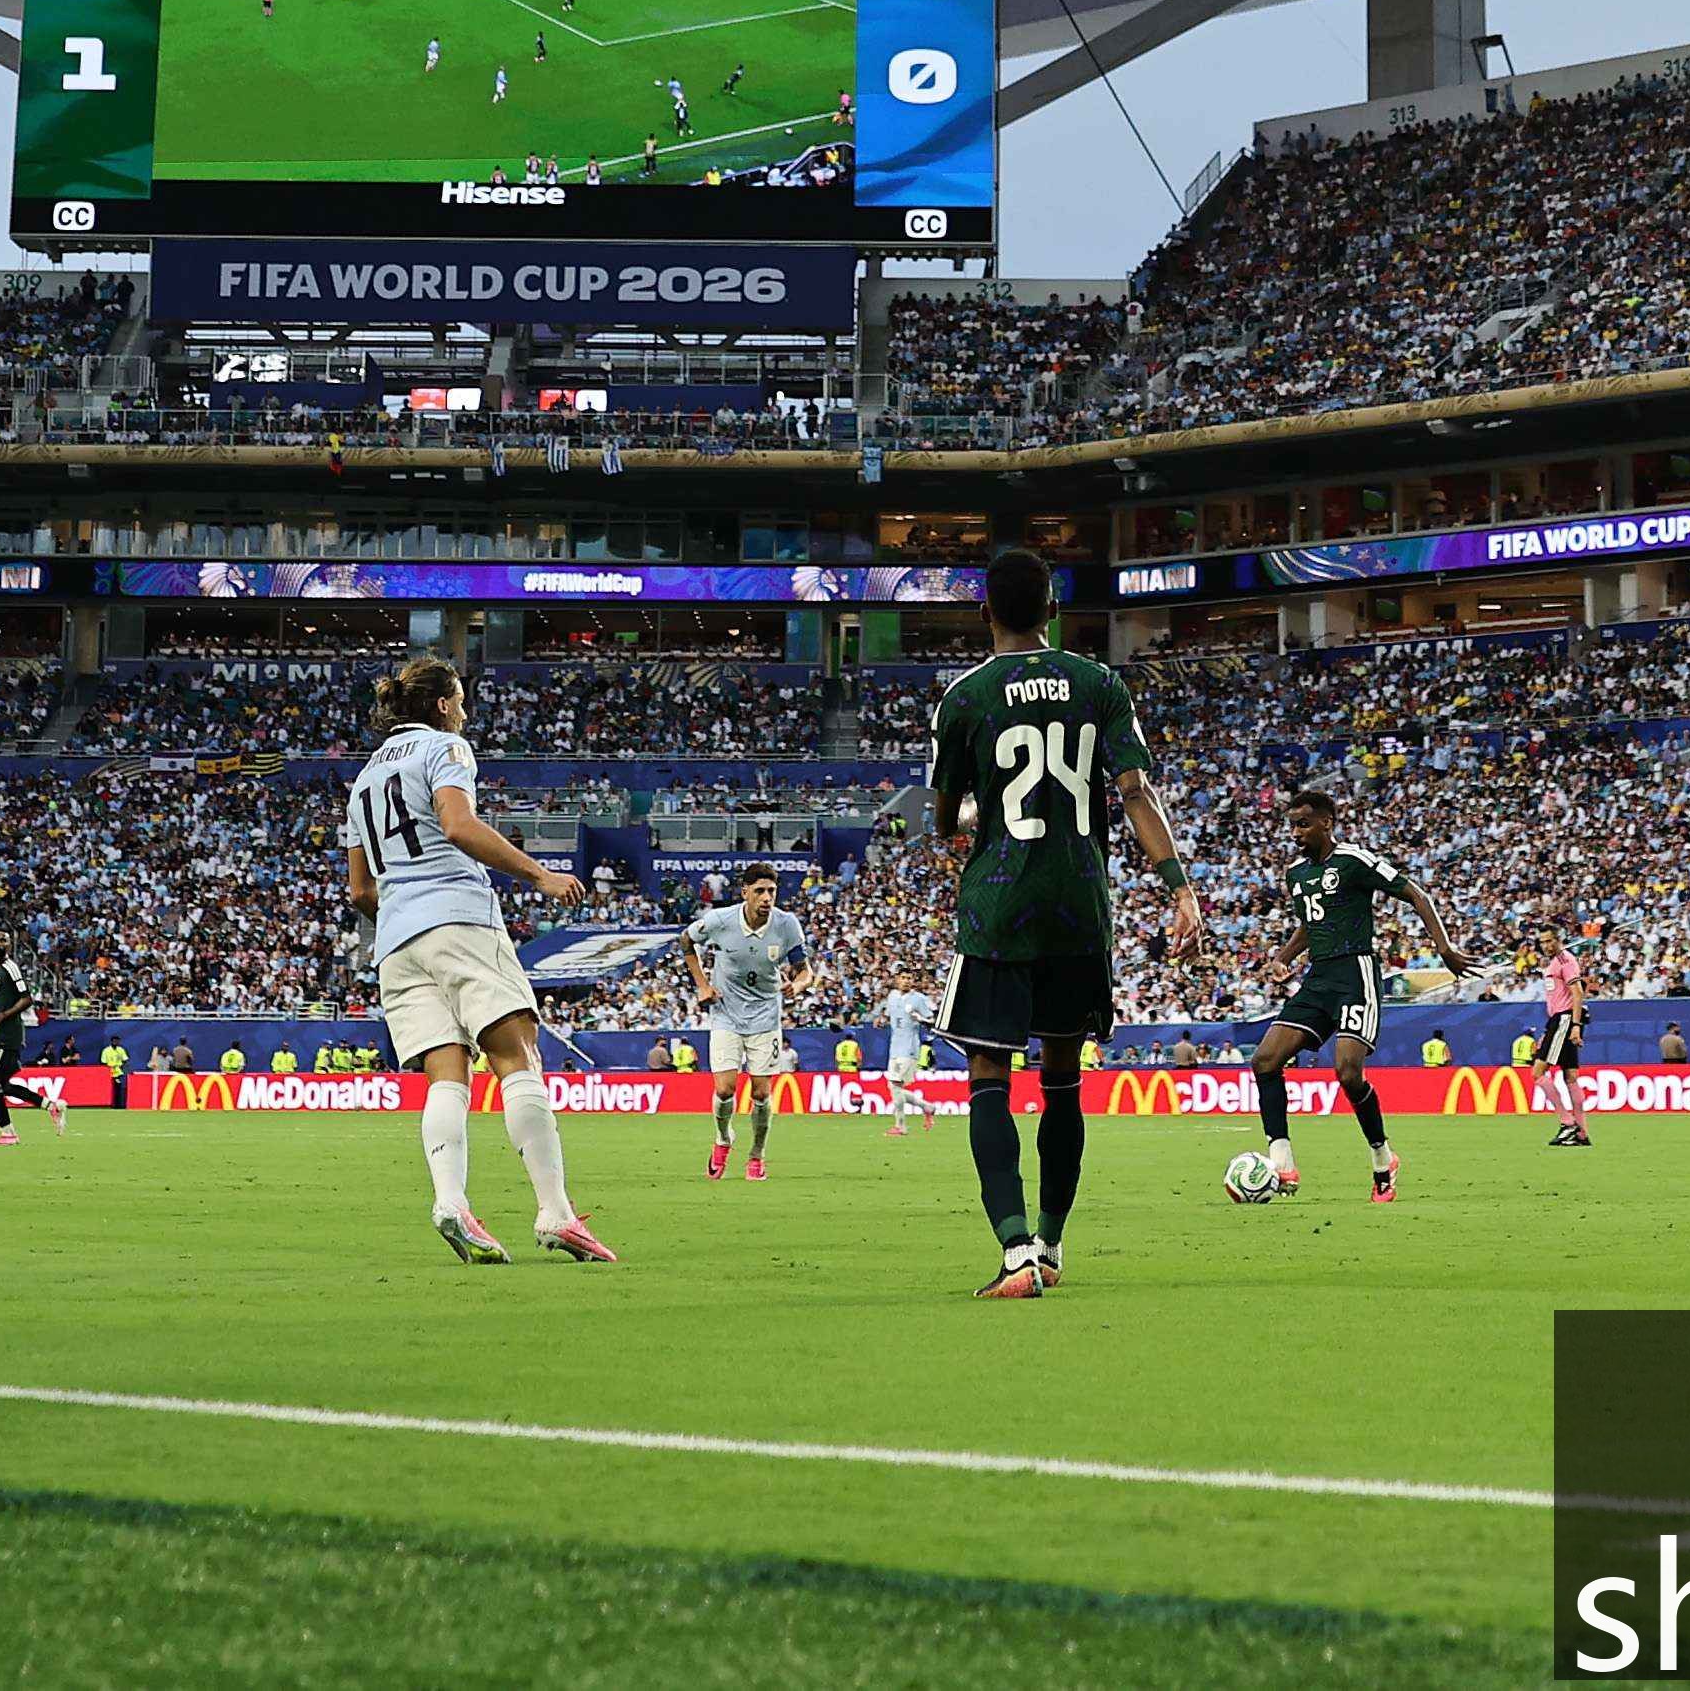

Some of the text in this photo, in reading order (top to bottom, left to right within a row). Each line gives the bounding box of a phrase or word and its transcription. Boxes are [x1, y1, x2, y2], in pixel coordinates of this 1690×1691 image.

[62, 36, 117, 91] 1
[889, 48, 958, 105] 0
[1389, 104, 1417, 125] 313
[441, 181, 566, 205] Hisense
[57, 206, 90, 226] CC
[910, 214, 942, 234] CC
[3, 273, 43, 292] 309
[218, 262, 787, 304] FIFA WORLD CUP 2026
[1486, 530, 1544, 560] FIFA
[1544, 522, 1639, 555] WORLD
[523, 572, 643, 596] #FIFAWorldCup
[1118, 564, 1197, 595] MIAMI
[1004, 677, 1071, 707] MOTEB
[995, 721, 1097, 840] 24
[358, 771, 425, 874] 14
[540, 858, 573, 871] 026
[652, 859, 681, 872] FIFA
[683, 859, 733, 872] WORLD
[1303, 892, 1325, 922] 15
[747, 970, 758, 987] 8
[1340, 1004, 1365, 1031] 15
[772, 1037, 780, 1059] 8
[239, 1076, 402, 1111] McDonald's
[548, 1074, 664, 1115] Delivery
